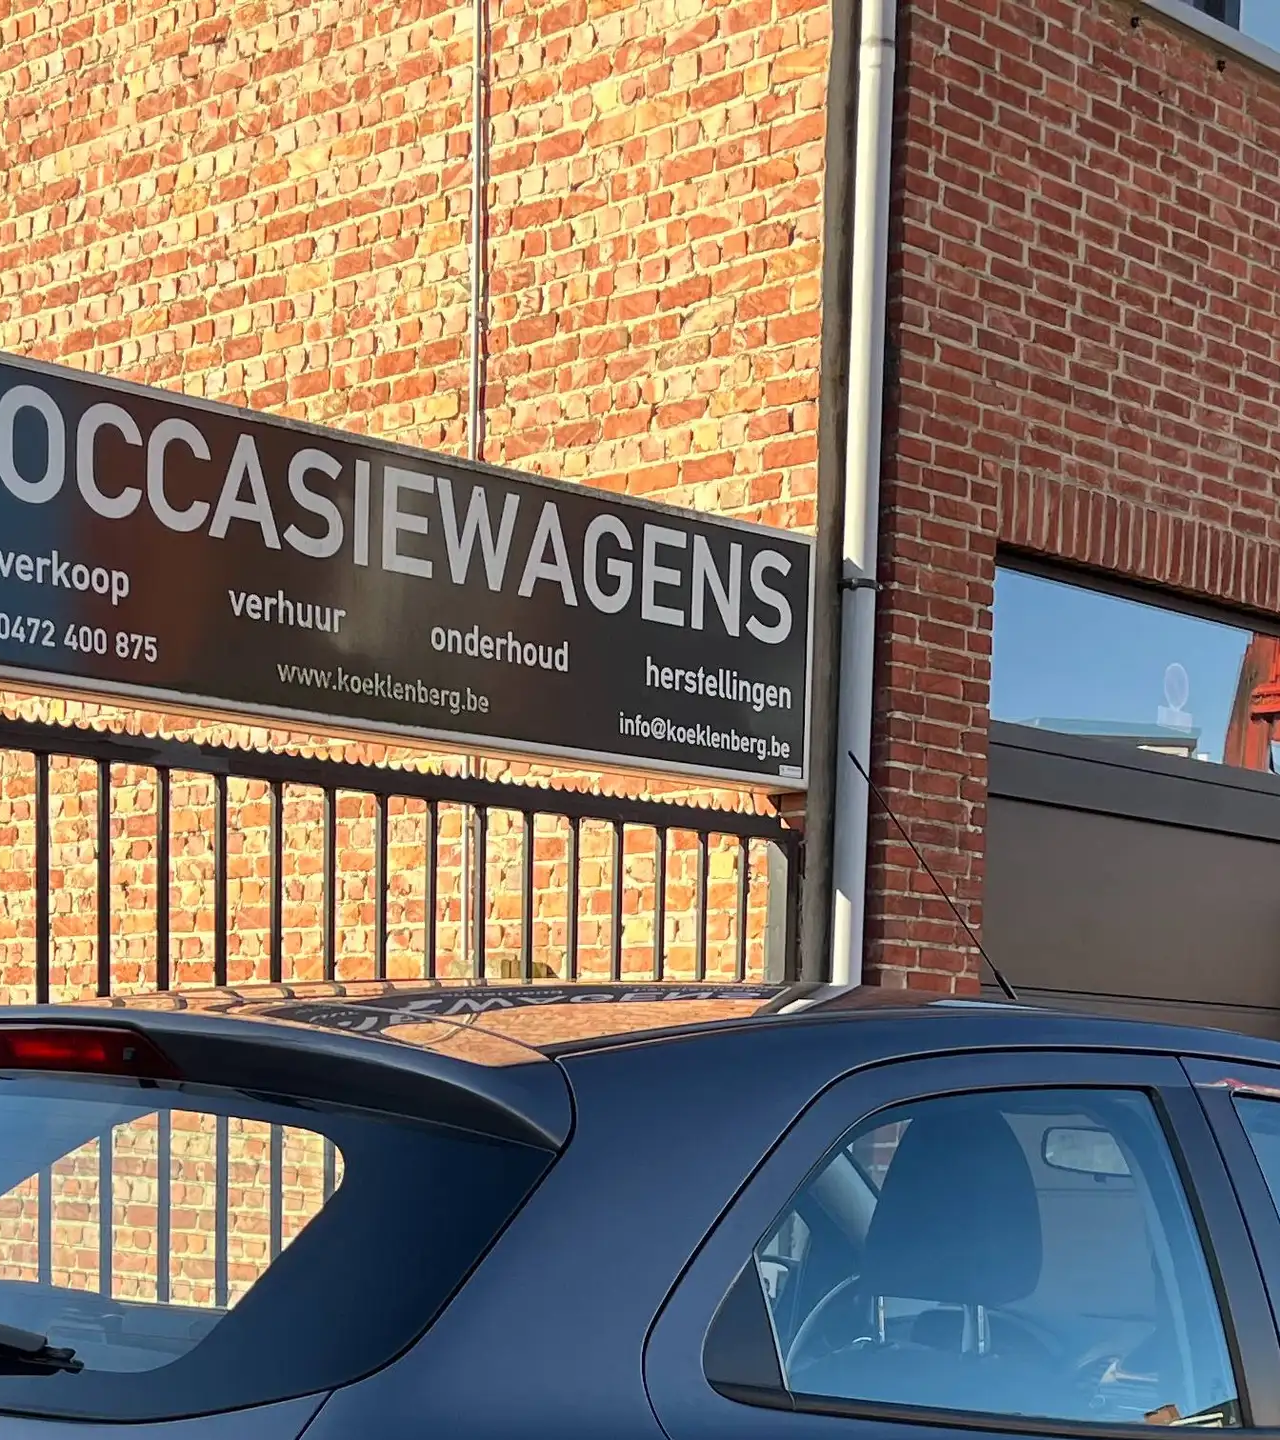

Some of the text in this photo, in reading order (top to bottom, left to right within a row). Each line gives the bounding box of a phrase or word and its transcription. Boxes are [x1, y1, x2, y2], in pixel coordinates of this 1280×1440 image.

[228, 589, 347, 633] verhuur
[63, 624, 108, 655] 400
[115, 634, 159, 663] 875
[431, 624, 569, 672] onderhoud
[277, 663, 489, 715] www.koeklenberg.be
[646, 656, 791, 712] herstellingen
[619, 711, 791, 761] info@koeklenberg.be
